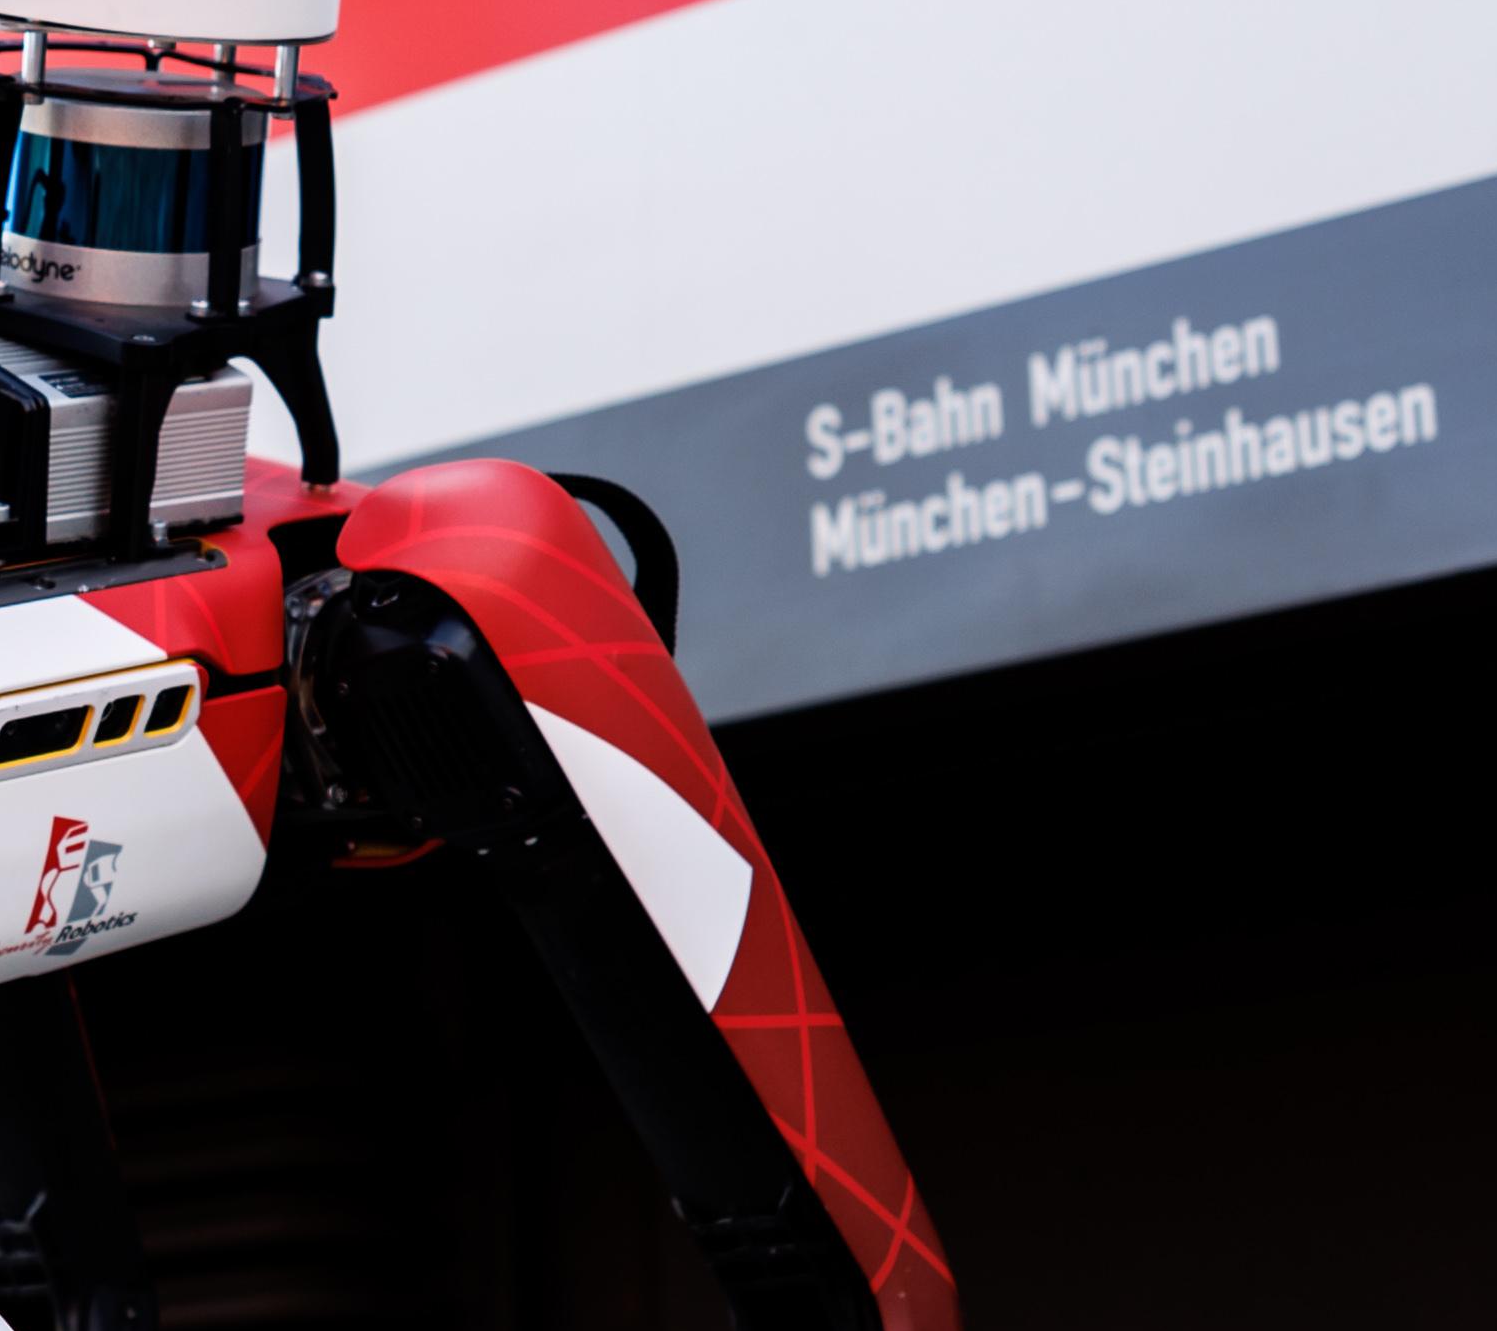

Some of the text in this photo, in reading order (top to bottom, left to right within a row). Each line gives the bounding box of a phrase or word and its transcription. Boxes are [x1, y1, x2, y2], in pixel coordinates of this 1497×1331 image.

[1, 246, 77, 283] elodyne
[804, 313, 1282, 481] S-Bahn München
[808, 380, 1440, 579] München-Steinhausen
[55, 911, 139, 944] Robotics
